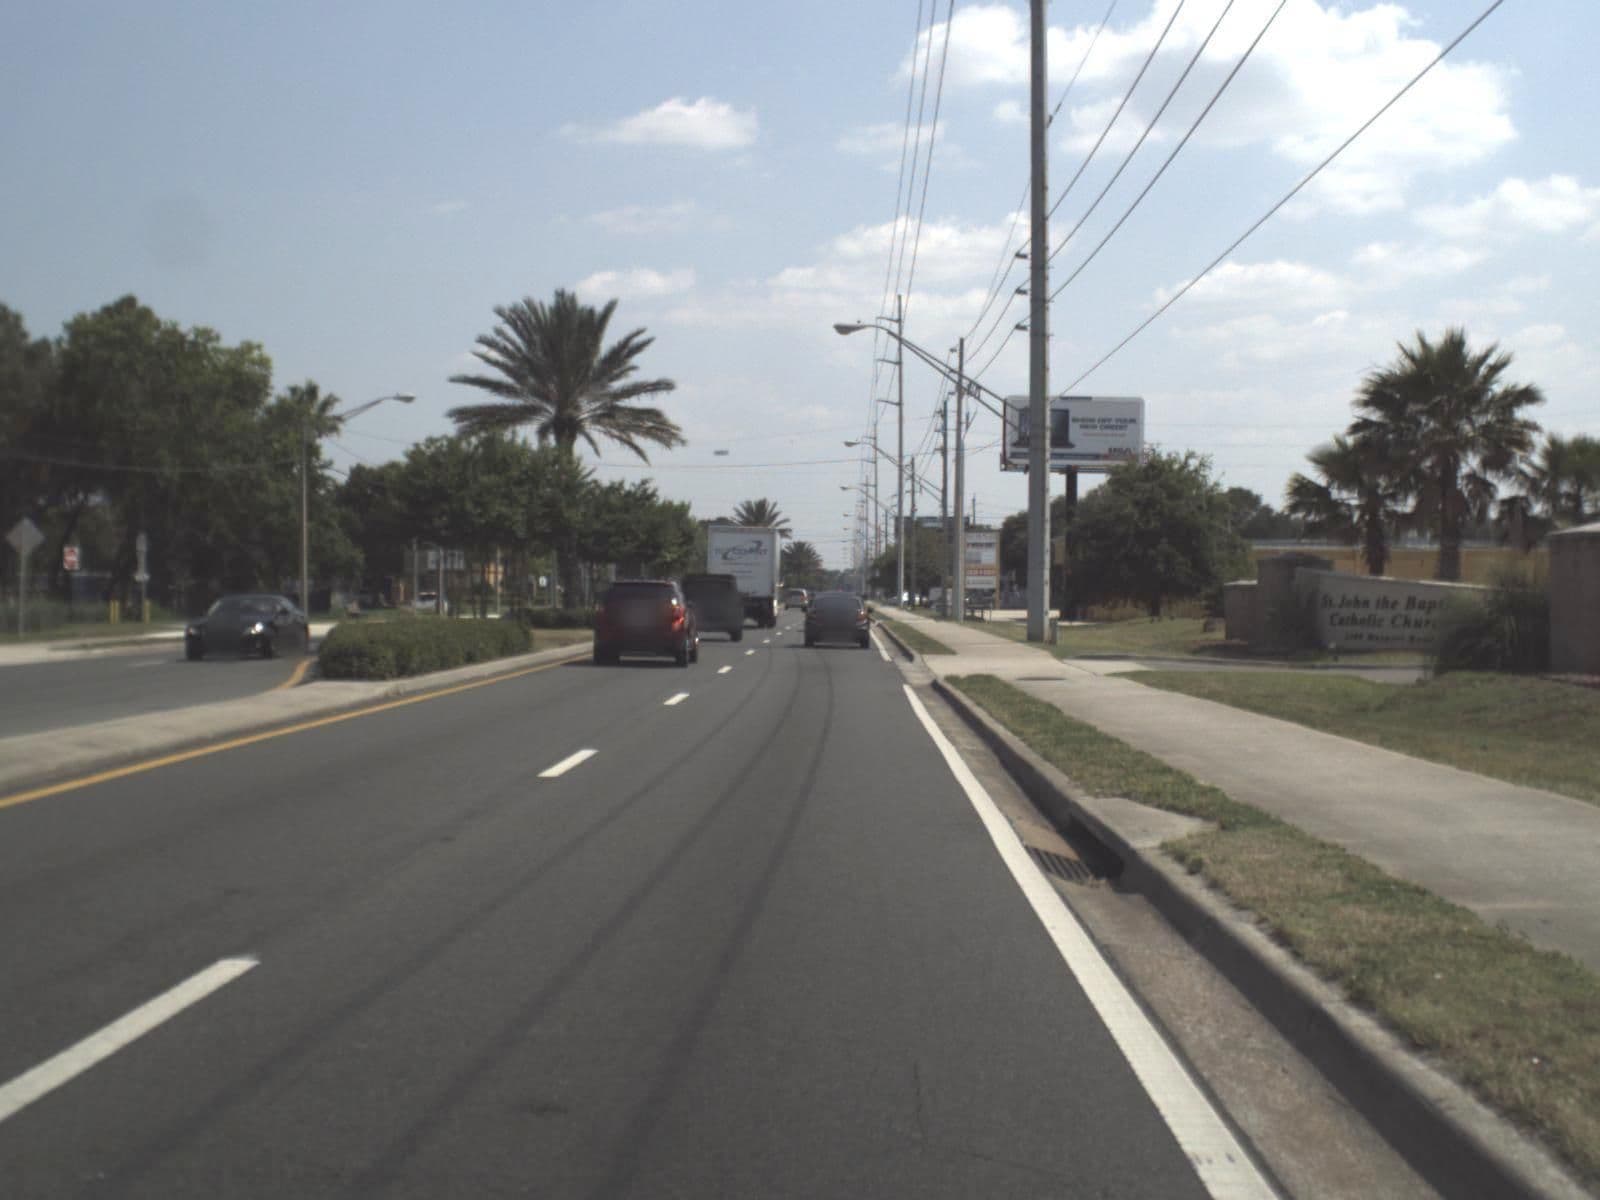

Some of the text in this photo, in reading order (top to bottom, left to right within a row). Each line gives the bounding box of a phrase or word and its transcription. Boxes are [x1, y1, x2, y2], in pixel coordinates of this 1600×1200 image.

[1336, 594, 1370, 610] John
[1375, 594, 1400, 610] the
[1328, 611, 1385, 629] Catholic
